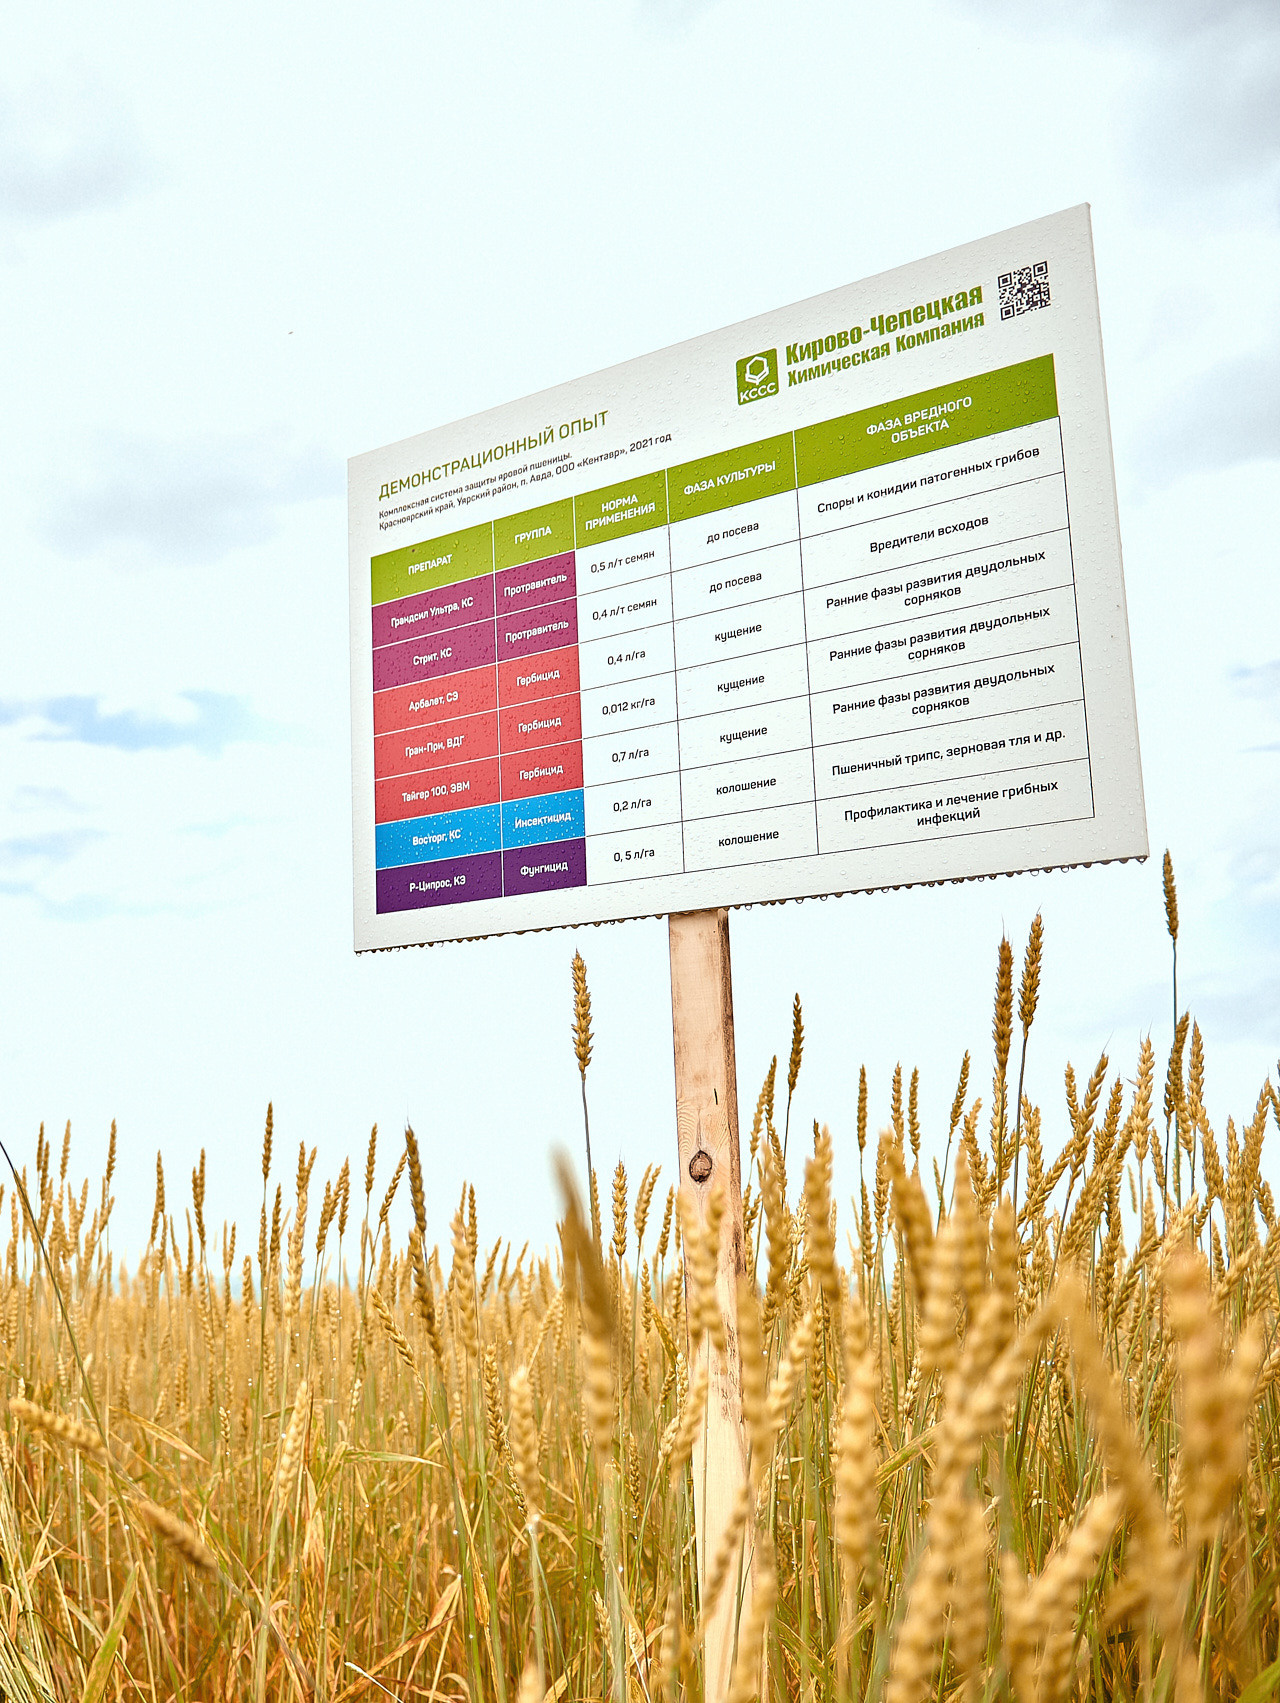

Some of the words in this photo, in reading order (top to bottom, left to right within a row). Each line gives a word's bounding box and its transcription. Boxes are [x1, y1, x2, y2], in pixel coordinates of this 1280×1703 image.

[785, 285, 983, 366] Кирово-Чепецкая
[787, 342, 891, 388] Химическая
[895, 311, 985, 353] Компания
[740, 382, 776, 403] KCCC
[866, 417, 903, 436] ФАЗА
[903, 396, 973, 425] ВРЕДНОГО
[891, 418, 950, 444] ОБЪЕКТА
[378, 426, 555, 502] ДЕМОНСТРАЦИОННЫЙ
[558, 410, 609, 440] ОПЫТ
[379, 506, 434, 531] Красноярский
[434, 500, 456, 514] край,
[491, 481, 519, 497] район,
[529, 470, 554, 484] Авда,
[555, 461, 575, 475] ООО
[576, 448, 628, 468] «Кентавр»,
[629, 437, 653, 453] 2021
[654, 433, 672, 445] год
[430, 486, 464, 503] система
[464, 475, 497, 492] защиты
[498, 464, 528, 482] яровой
[683, 478, 716, 495] ФАЗА
[716, 460, 776, 487] КУЛЬТУРЫ
[817, 496, 855, 513] Споры
[857, 494, 865, 503] и
[866, 480, 917, 501] конидии
[920, 460, 993, 487] патогенных
[995, 447, 1040, 468] грибов
[601, 493, 639, 513] НОРМА
[585, 501, 656, 531] ПРИМЕНЕНИЯ
[514, 525, 553, 545] ГРУППА
[706, 533, 720, 545] до
[722, 522, 759, 539] посева
[869, 529, 935, 554] Вредители
[937, 516, 989, 537] всходов
[407, 553, 453, 576] ПРЕПАРАТ
[590, 561, 606, 574] 0,5
[607, 558, 623, 570] л/т
[625, 550, 655, 565] семян
[503, 574, 568, 598] Протравитель
[709, 582, 723, 594] до
[724, 572, 762, 589] посева
[826, 592, 869, 609] Ранние
[870, 584, 903, 601] фазы
[905, 570, 963, 594] развития
[964, 551, 1046, 579] двудольных
[904, 586, 962, 607] сорняков
[390, 610, 429, 629] Грандсил
[429, 602, 460, 617] Ультра,
[461, 596, 474, 609] КС
[592, 609, 608, 621] 0,4
[609, 605, 626, 617] л/т
[627, 598, 657, 612] семян
[505, 620, 569, 644] Протравитель
[714, 624, 762, 643] кущение
[829, 645, 872, 662] Ранние
[874, 638, 907, 654] фазы
[909, 625, 967, 648] развития
[969, 607, 1051, 634] двудольных
[412, 652, 439, 666] Стрит,
[440, 647, 453, 659] КС
[607, 653, 623, 666] 0,4
[624, 650, 646, 662] л/га
[907, 641, 966, 661] сорняков
[516, 669, 561, 687] Гербицид
[717, 675, 765, 693] кущение
[446, 690, 459, 703] СЭ
[832, 699, 876, 715] Ранние
[877, 692, 911, 708] фазы
[913, 680, 971, 702] развития
[973, 664, 1055, 690] двудольных
[602, 701, 629, 716] 0,012
[630, 697, 656, 710] кг/га
[911, 697, 970, 715] сорняков
[518, 717, 562, 734] Гербицид
[719, 726, 768, 745] кущение
[405, 741, 446, 759] Гран-При,
[446, 735, 465, 749] ВДГ
[611, 751, 627, 763] 0,7
[628, 748, 650, 760] л/га
[832, 754, 903, 776] Пшеничный
[904, 750, 944, 766] трипс,
[946, 739, 1006, 758] зерновая
[1008, 735, 1031, 747] тля
[1033, 733, 1042, 743] и
[1045, 730, 1066, 743] др.
[519, 764, 564, 781] Гербицид
[430, 784, 449, 797] 100,
[450, 780, 470, 794] ЭВМ
[716, 778, 777, 796] колошение
[613, 800, 629, 813] 0,2
[630, 798, 652, 810] л/га
[844, 800, 933, 823] Профилактика
[935, 798, 943, 808] и
[945, 790, 999, 806] лечение
[1002, 781, 1059, 800] грибных
[514, 812, 572, 829] Инсектицид
[916, 806, 981, 827] инфекций
[412, 833, 448, 846] Восторг,
[448, 828, 462, 841] КС
[718, 830, 780, 847] колошение
[633, 848, 655, 860] л/га
[520, 861, 569, 878] Фунгицид
[409, 879, 453, 893] Р-Ципрос,
[453, 874, 466, 886] КЭ
